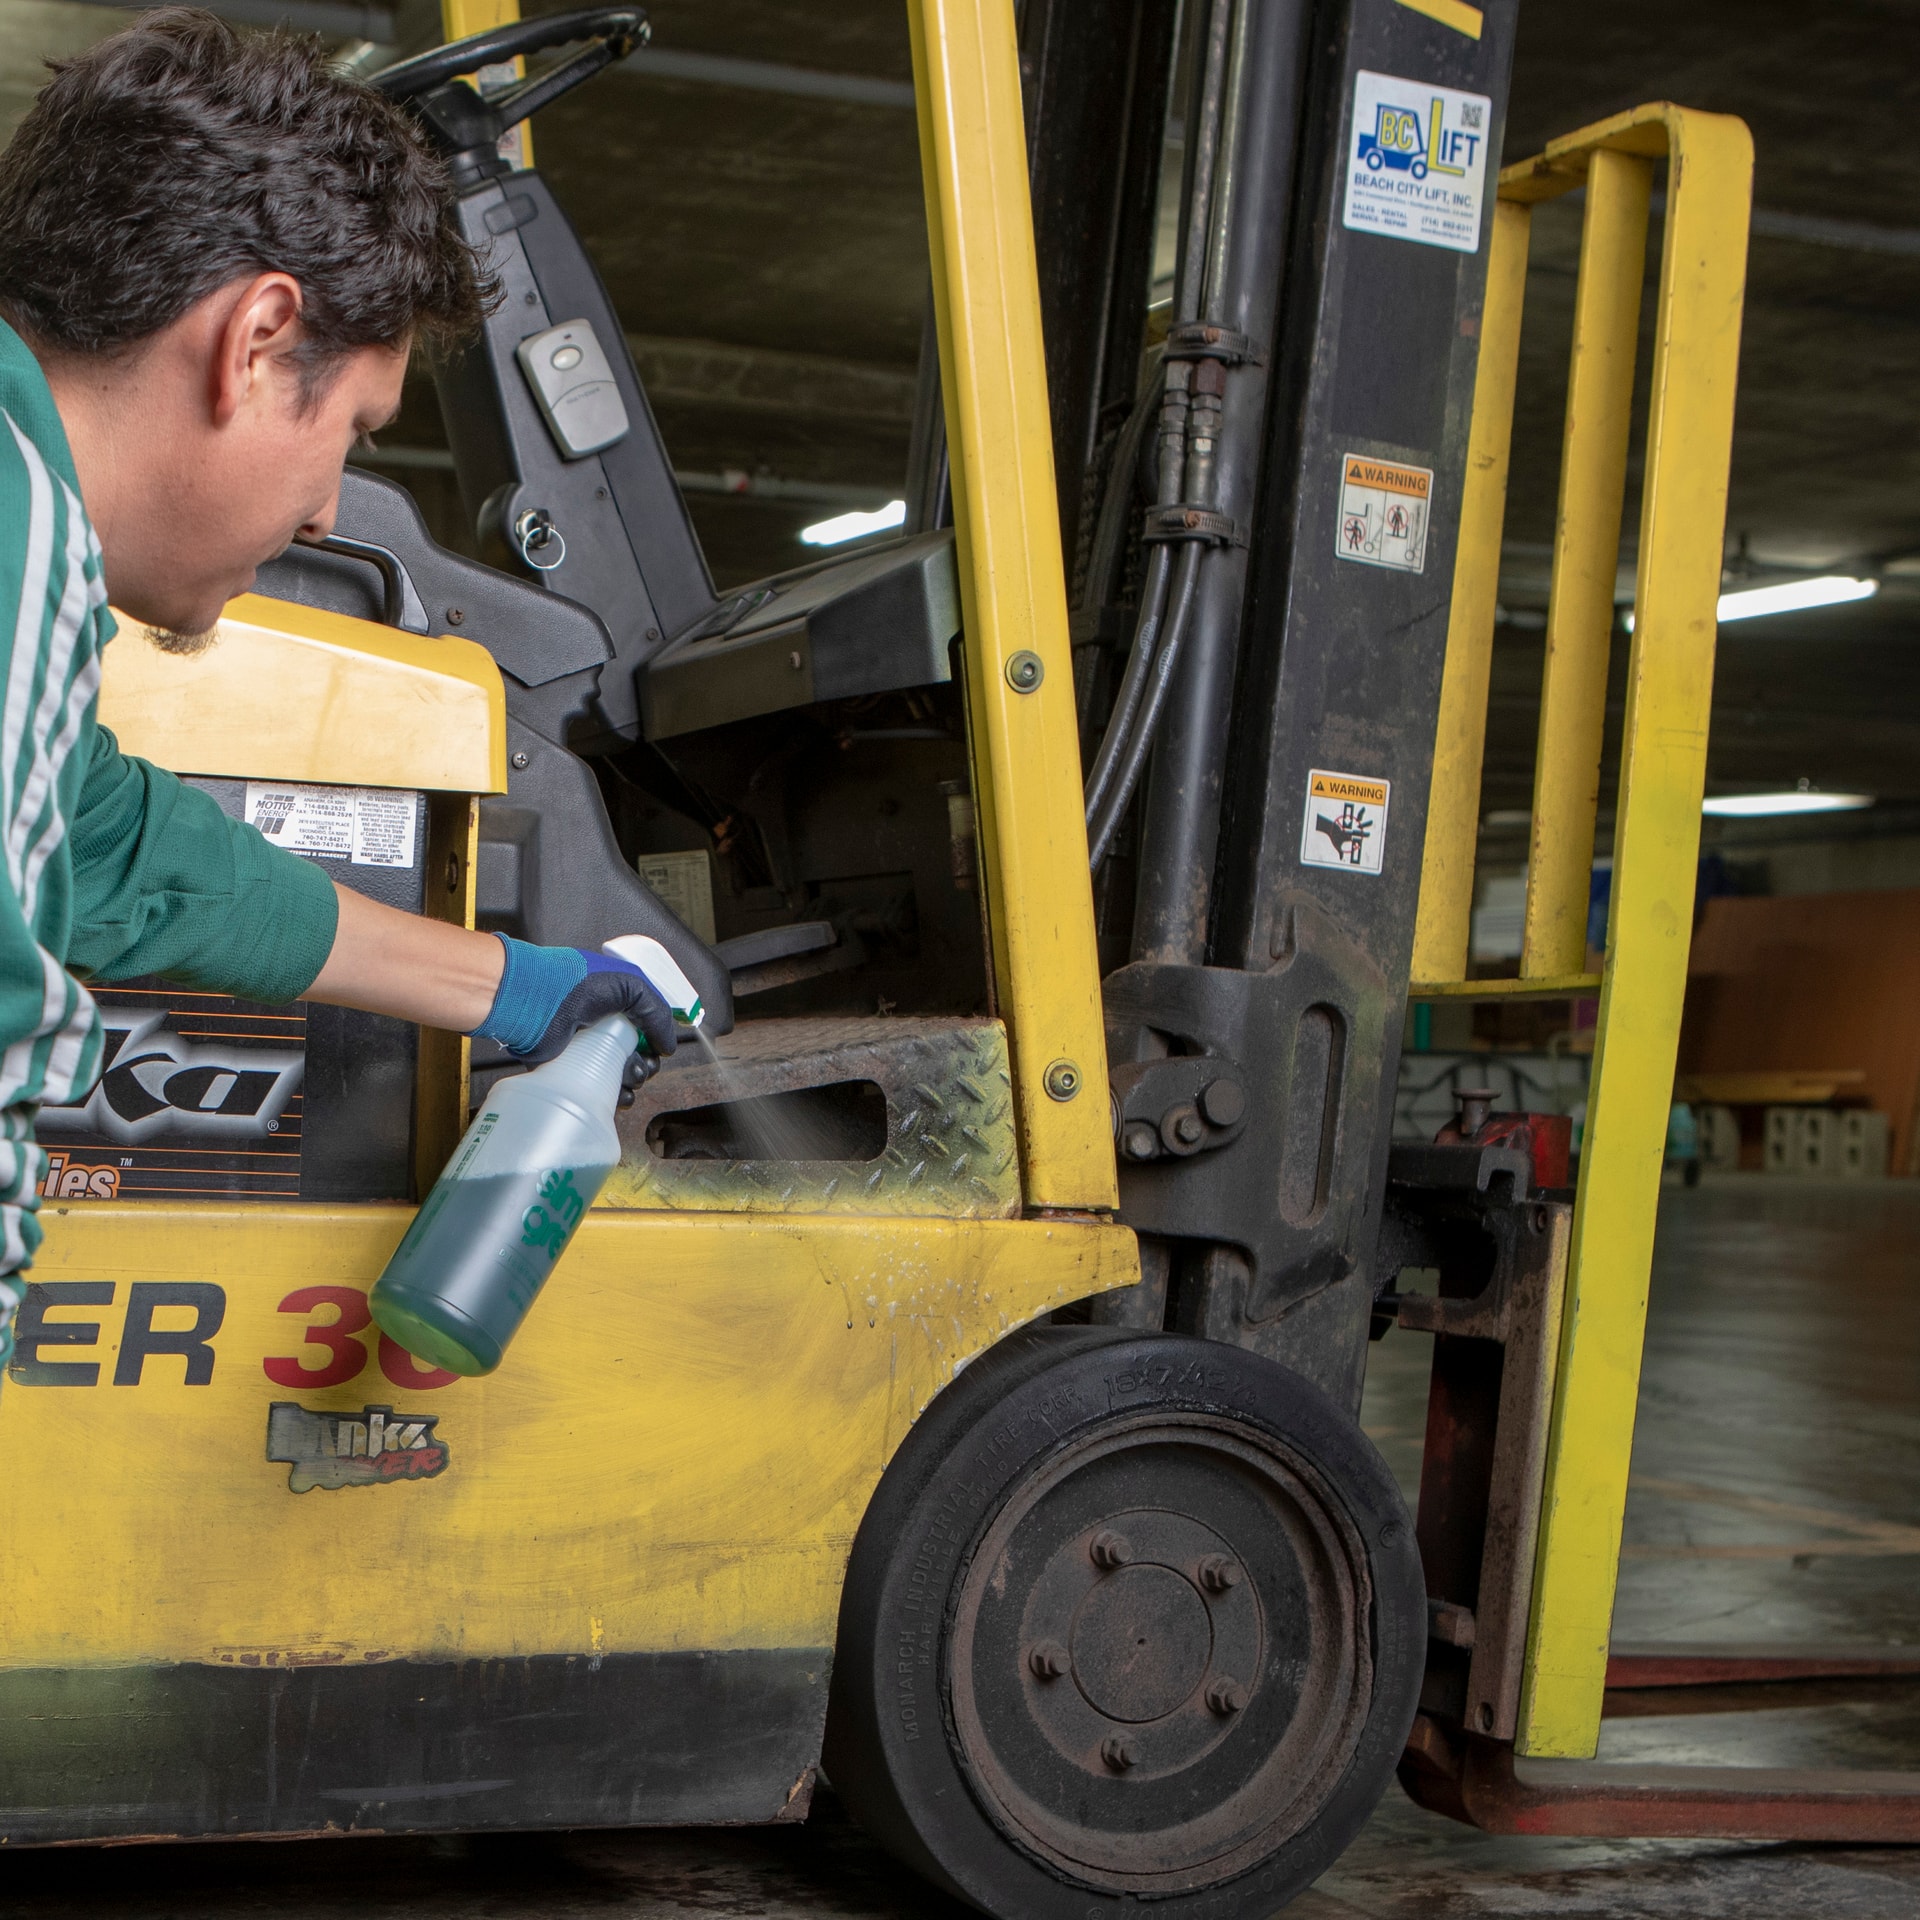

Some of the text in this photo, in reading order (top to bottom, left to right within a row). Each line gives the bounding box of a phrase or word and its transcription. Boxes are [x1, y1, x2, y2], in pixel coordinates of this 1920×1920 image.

[1380, 111, 1414, 150] BC
[1354, 172, 1394, 191] BEACH
[1397, 180, 1423, 197] CITY
[1425, 186, 1449, 205] LIFT,
[1452, 193, 1474, 209] INC.
[1364, 466, 1427, 492] WARNING
[255, 800, 296, 811] MOTIVE
[1329, 782, 1384, 800] WARNING
[257, 809, 290, 817] ENERGY
[973, 1418, 1024, 1471] TIRE
[903, 1472, 976, 1611] INDUSTRIAL
[897, 1628, 921, 1743] MONARCH
